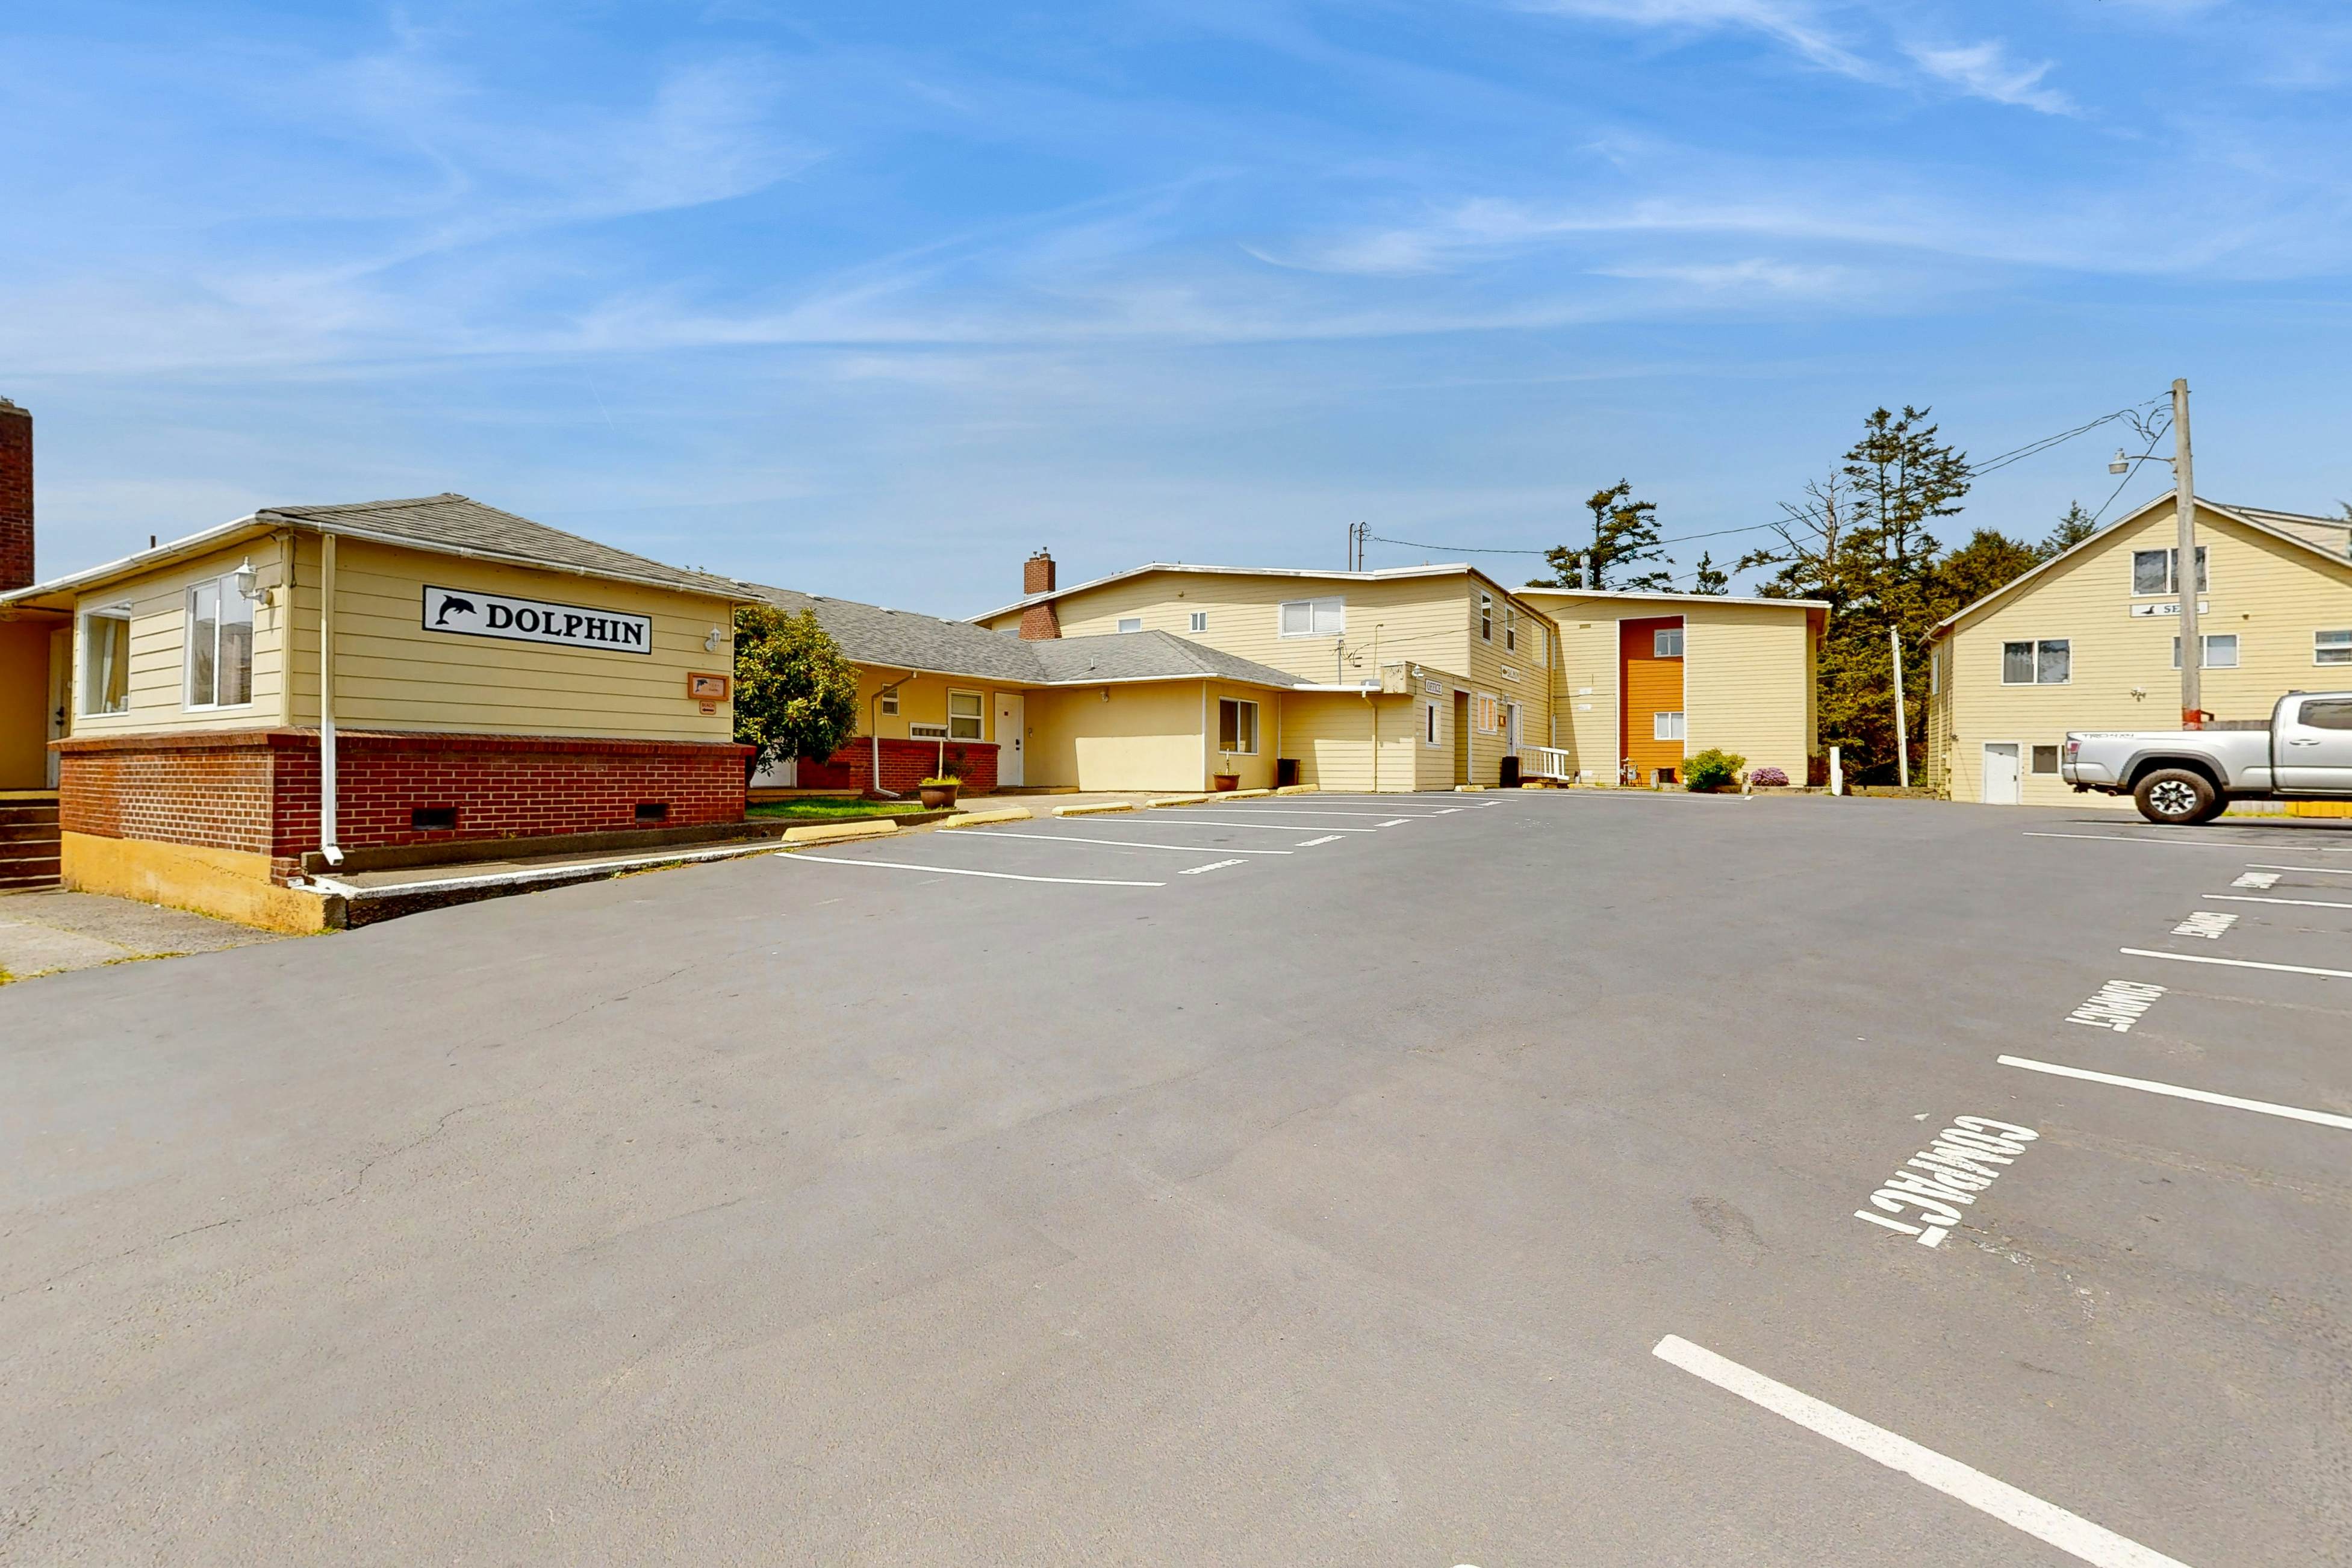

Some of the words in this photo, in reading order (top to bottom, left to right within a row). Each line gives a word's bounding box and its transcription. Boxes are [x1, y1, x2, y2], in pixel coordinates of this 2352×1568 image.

[485, 603, 644, 646] DOLPHIN
[2164, 605, 2200, 614] SE
[1427, 681, 1441, 693] OFFICE
[2064, 979, 2168, 1033] COMPACT
[1853, 1115, 2040, 1248] COMPACT
